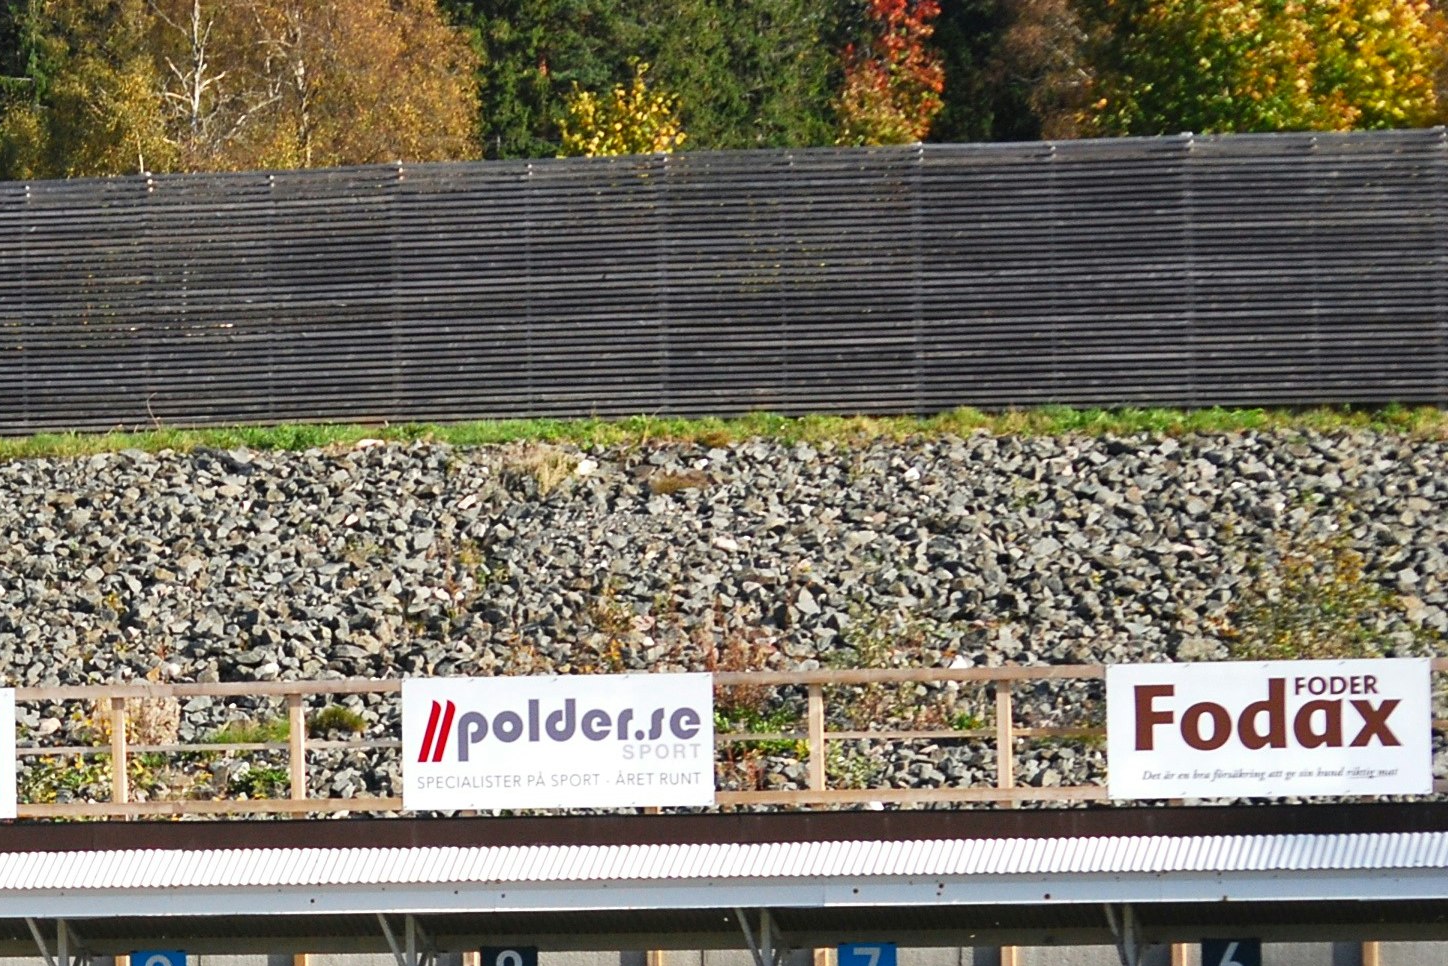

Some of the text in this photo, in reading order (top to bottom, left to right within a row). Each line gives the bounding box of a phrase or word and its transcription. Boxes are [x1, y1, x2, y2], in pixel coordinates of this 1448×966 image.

[1294, 675, 1379, 695] FODER
[1133, 677, 1403, 751] Fodax
[622, 743, 702, 760] SPORT
[417, 774, 521, 789] SPECIALISTER
[528, 770, 546, 787] PÅ
[551, 773, 600, 787] SPORT
[616, 770, 654, 786] ÅRET
[660, 772, 701, 785] RUNT
